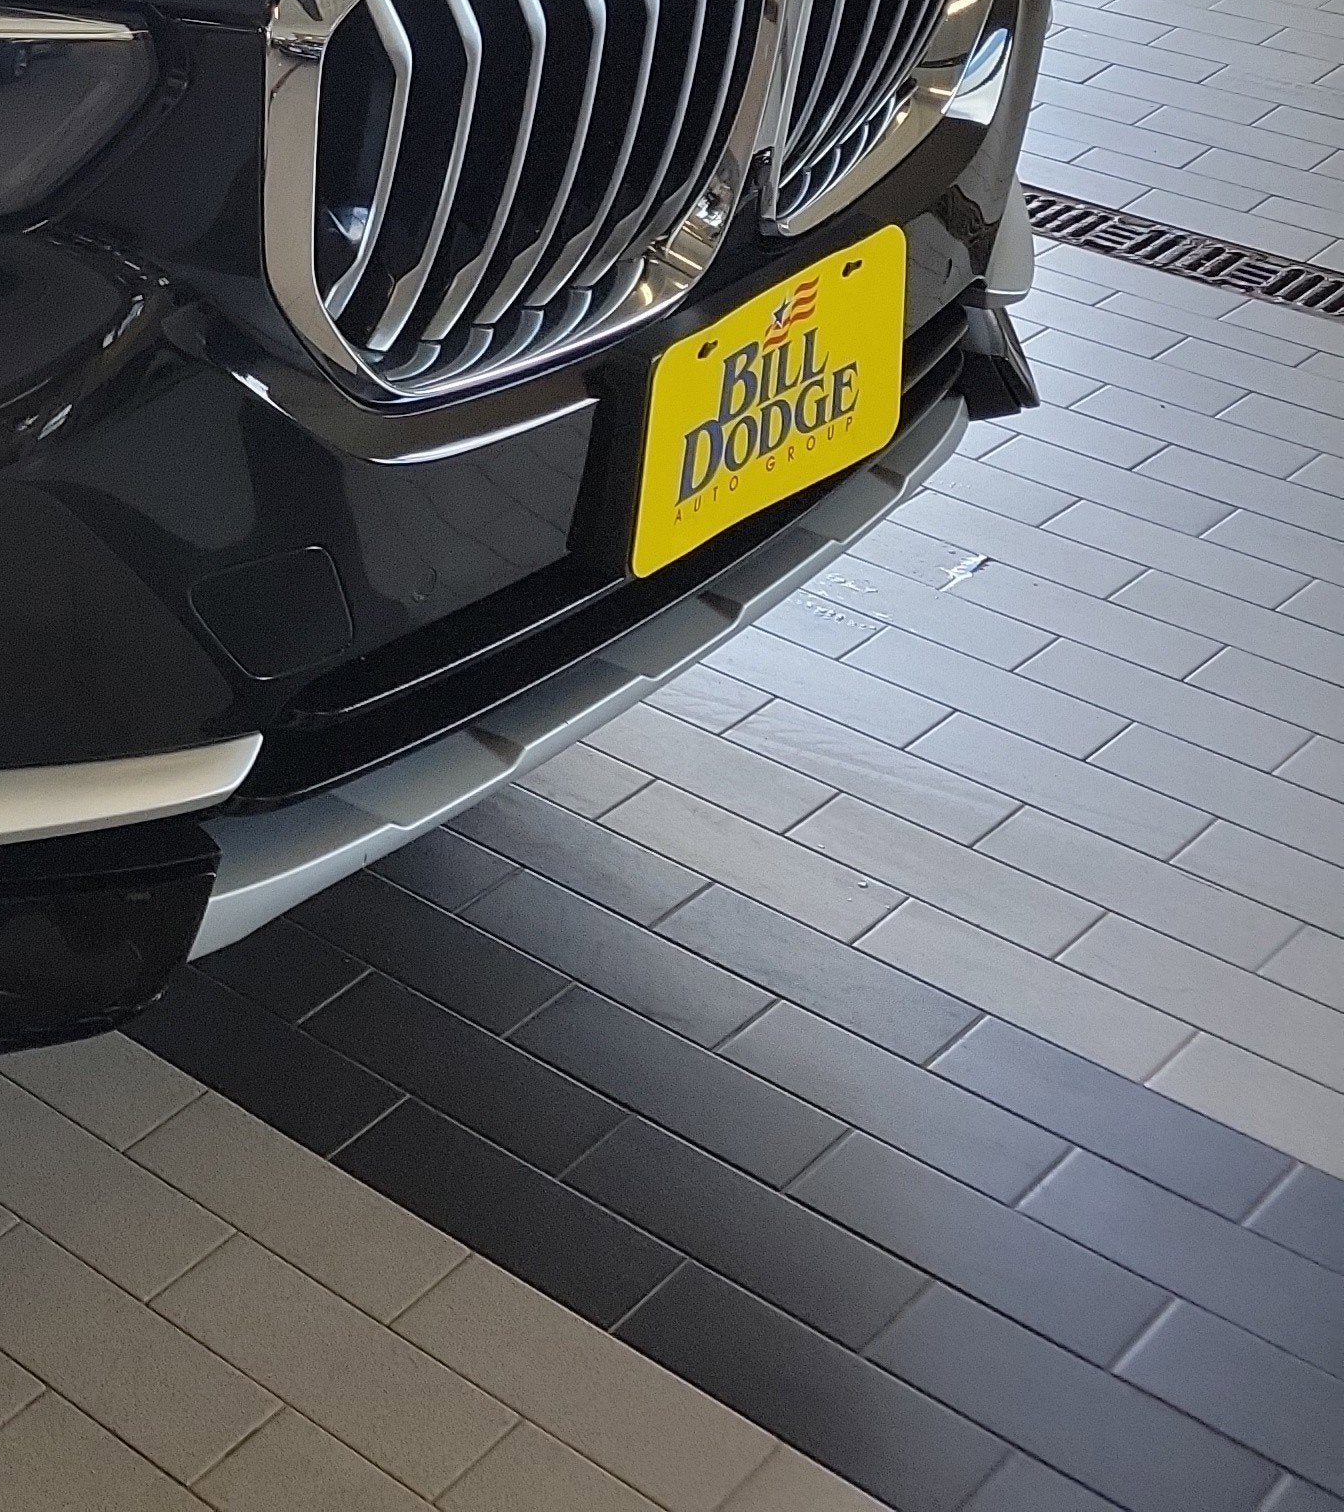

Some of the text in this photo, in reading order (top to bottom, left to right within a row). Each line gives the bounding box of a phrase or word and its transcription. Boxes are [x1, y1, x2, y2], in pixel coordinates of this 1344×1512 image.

[716, 327, 830, 423] BILL
[673, 415, 855, 526] AUTO GROUP
[674, 361, 861, 508] DODGE
